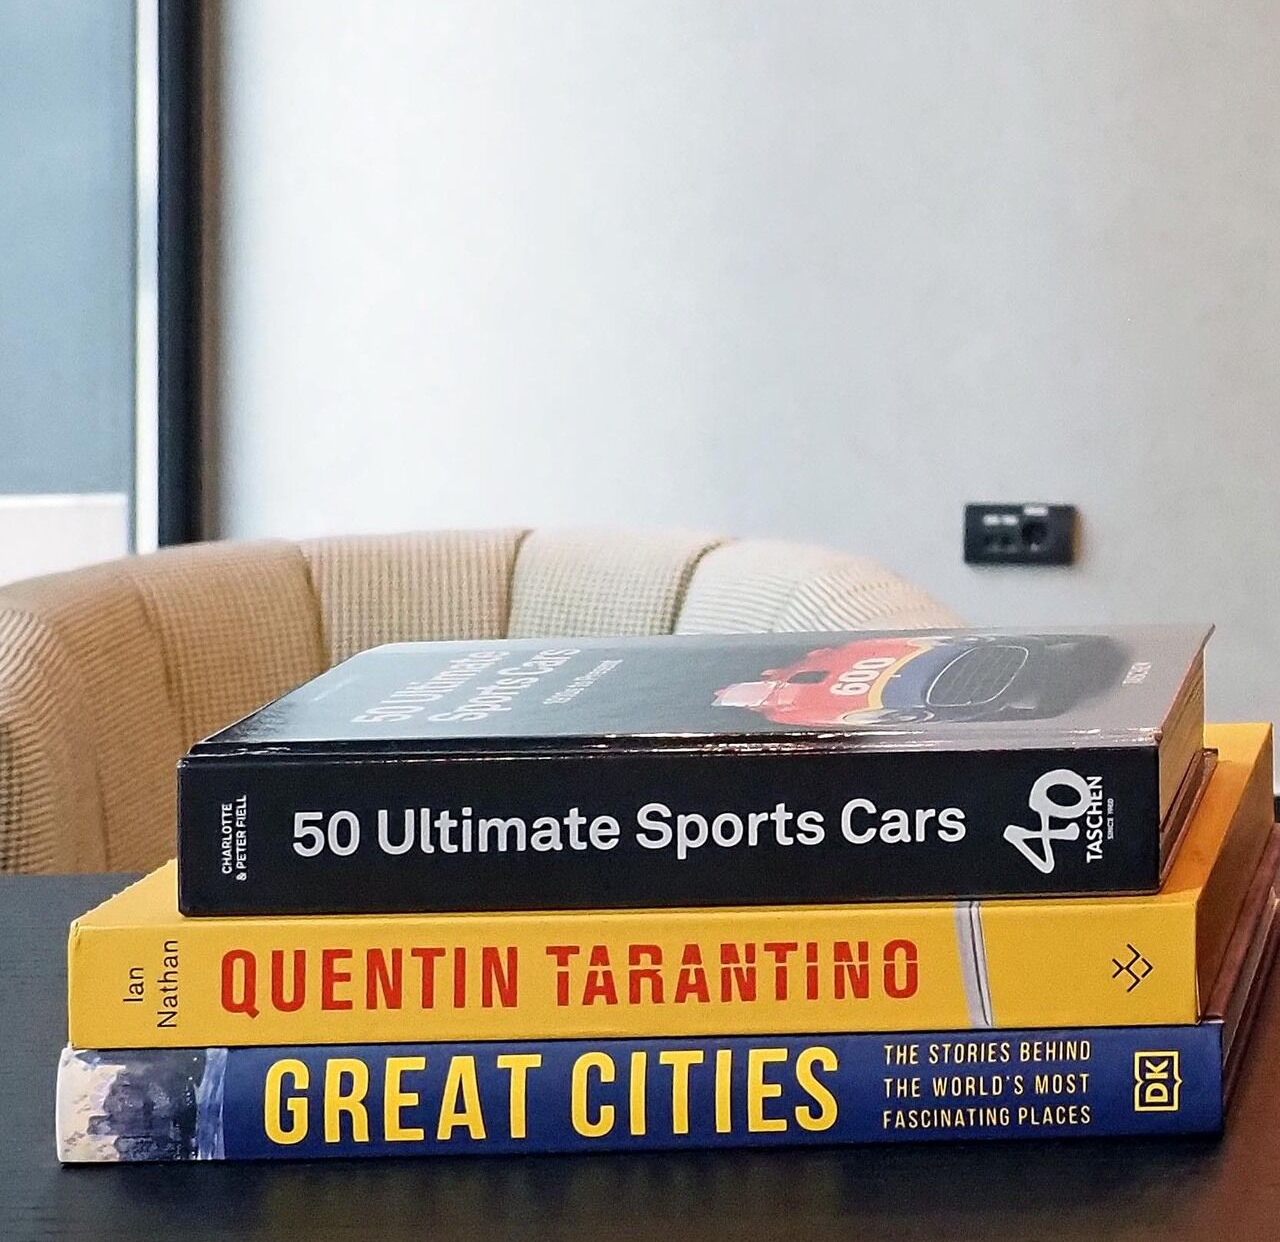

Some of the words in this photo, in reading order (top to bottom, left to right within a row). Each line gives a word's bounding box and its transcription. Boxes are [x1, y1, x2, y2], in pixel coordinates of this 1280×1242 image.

[379, 650, 510, 705] Ultimate
[427, 676, 540, 723] Sports
[498, 647, 581, 676] Cars
[829, 657, 897, 696] 600
[350, 704, 425, 723] 50
[235, 794, 248, 828] FIELL
[292, 810, 361, 857] 50
[377, 806, 622, 855] Ultimate
[635, 802, 826, 860] Sports
[841, 798, 967, 845] Cars
[1002, 768, 1092, 874] 40
[1085, 776, 1103, 864] TASCHEN
[221, 803, 233, 875] CHARLOTTE
[235, 830, 248, 870] PETER
[235, 871, 248, 882] &
[122, 966, 145, 1003] Ian
[156, 940, 179, 1028] Nathan
[221, 946, 518, 1018] QUENTIN
[545, 938, 919, 1007] TARANTINO
[884, 1044, 920, 1066] THE
[928, 1042, 1011, 1064] STORIES
[1019, 1040, 1091, 1063] BEHIND
[263, 1054, 542, 1146] GREAT
[571, 1046, 839, 1138] CITIES
[884, 1077, 921, 1099] THE
[932, 1074, 1024, 1098] WORLD'S
[1035, 1073, 1090, 1095] MOST
[1145, 1059, 1169, 1103] DK
[883, 1107, 1010, 1130] FASCINATING
[1018, 1105, 1091, 1126] PLACES
